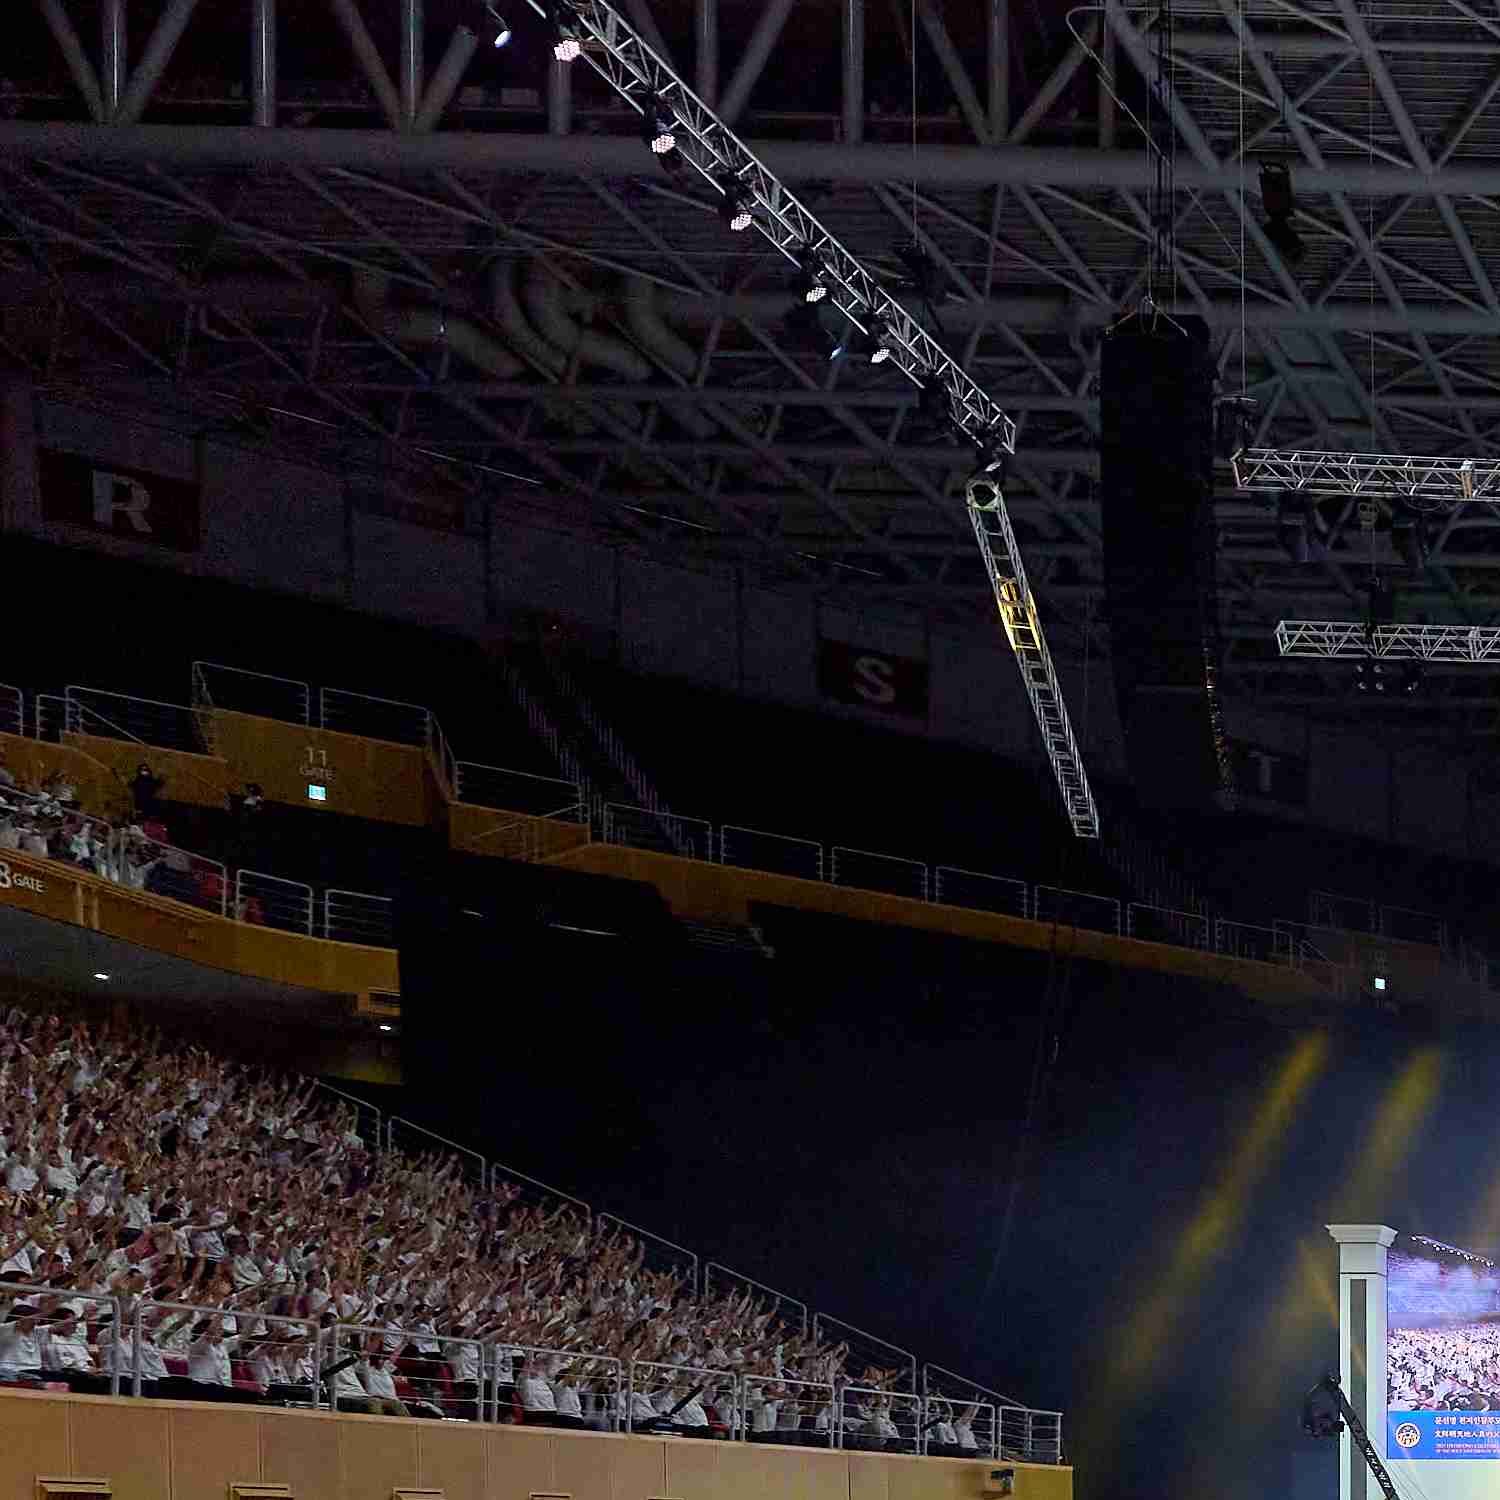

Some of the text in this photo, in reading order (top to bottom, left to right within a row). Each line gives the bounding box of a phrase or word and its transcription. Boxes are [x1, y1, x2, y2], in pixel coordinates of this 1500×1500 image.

[91, 469, 153, 533] R
[854, 656, 896, 704] S
[13, 872, 48, 894] GATE
